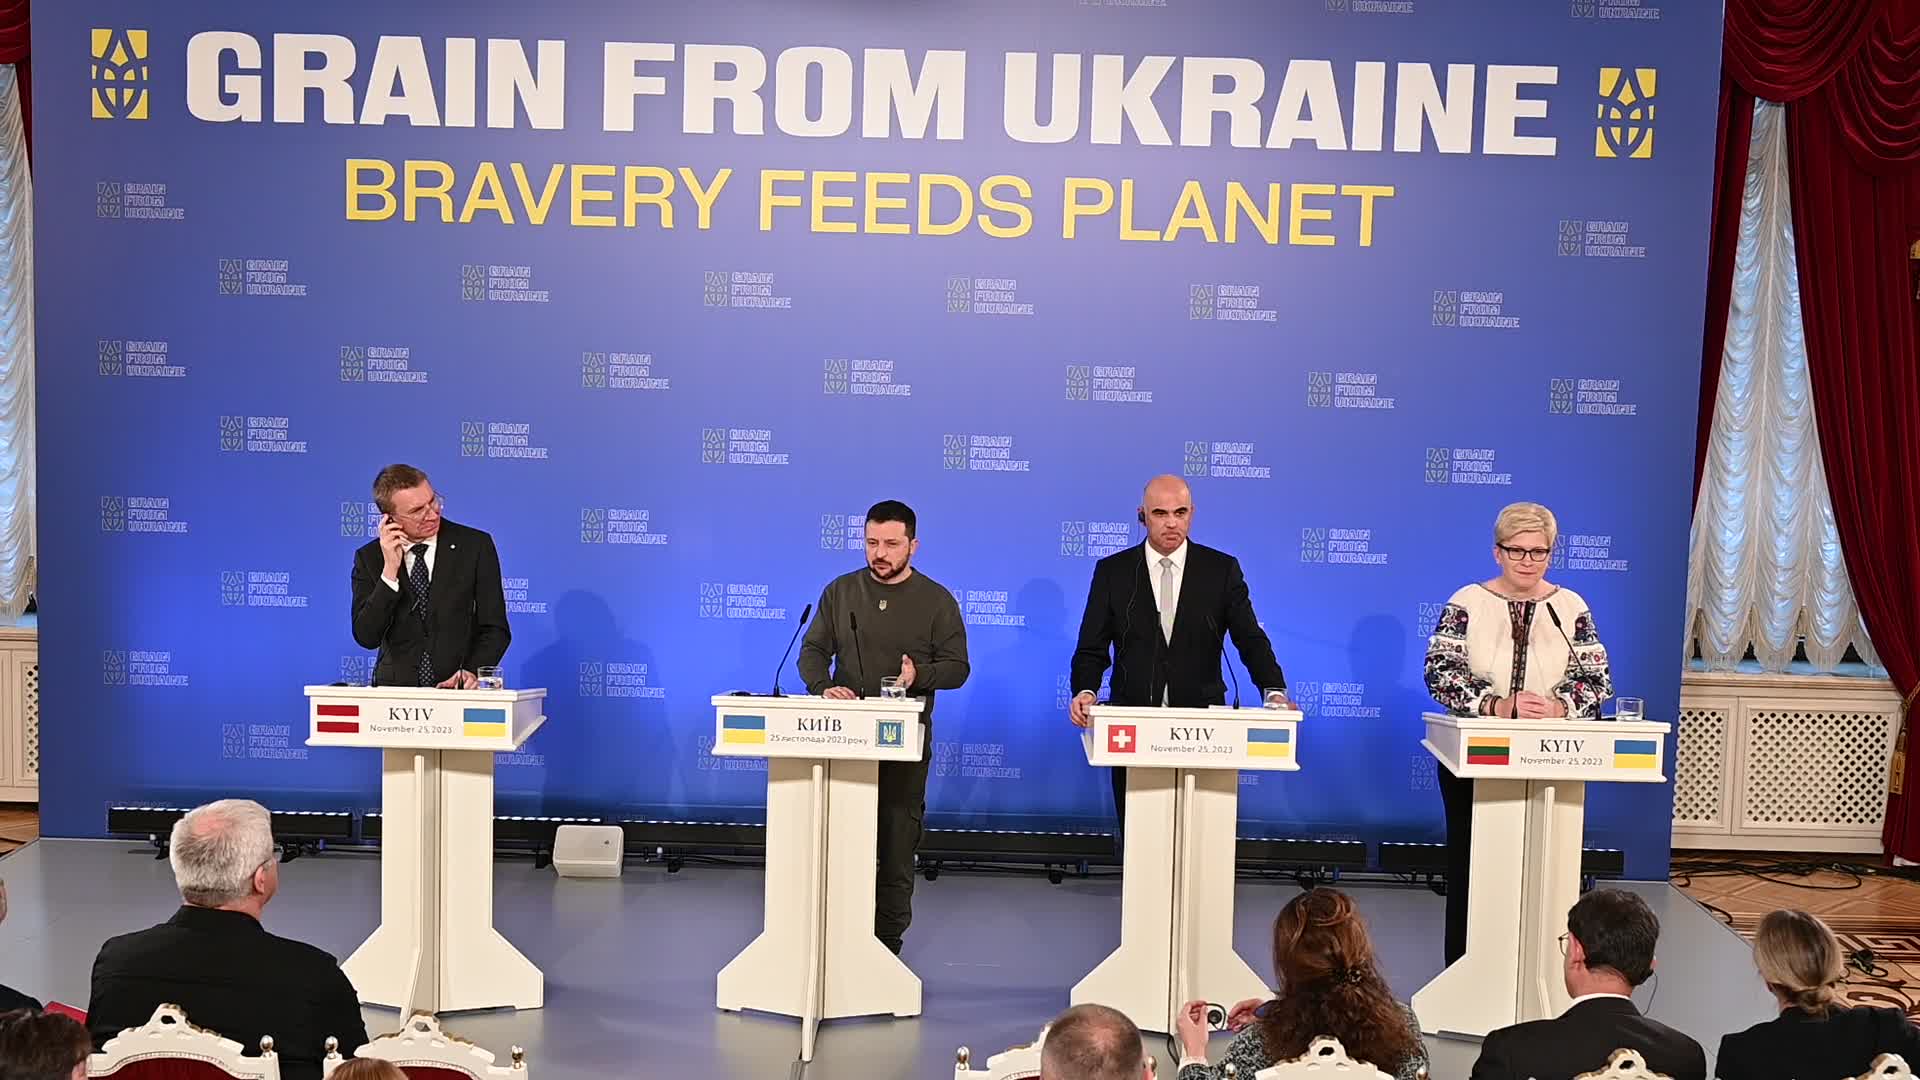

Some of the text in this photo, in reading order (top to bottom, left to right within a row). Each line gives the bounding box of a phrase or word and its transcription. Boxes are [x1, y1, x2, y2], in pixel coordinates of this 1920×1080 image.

[186, 31, 1558, 156] GRAIN FROM UKRAINE
[124, 184, 166, 194] GRAIN
[124, 195, 164, 206] FROM
[345, 159, 1395, 247] BRAVERY FEEDS PLANET
[124, 208, 184, 219] UKRAINE
[1586, 221, 1628, 232] GRAIN
[1586, 233, 1626, 244] FROM
[1585, 246, 1645, 257] UKRAINE
[246, 260, 288, 271] GRAIN
[489, 266, 530, 277] GRAIN
[247, 272, 286, 283] FROM
[732, 272, 773, 283] GRAIN
[489, 278, 528, 289] FROM
[975, 279, 1016, 290] GRAIN
[246, 284, 306, 295] UKRAINE
[732, 285, 771, 296] FROM
[1217, 285, 1259, 296] GRAIN
[489, 290, 549, 302] UKRAINE
[975, 291, 1014, 301] FROM
[1460, 292, 1502, 303] GRAIN
[732, 297, 791, 308] UKRAINE
[1217, 298, 1257, 308] FROM
[974, 303, 1034, 314] UKRAINE
[1460, 304, 1500, 315] FROM
[1217, 310, 1277, 321] UKRAINE
[1460, 316, 1520, 328] UKRAINE
[126, 341, 167, 352] GRAIN
[368, 347, 409, 358] GRAIN
[126, 354, 166, 364] FROM
[609, 353, 651, 364] GRAIN
[368, 359, 407, 370] FROM
[852, 360, 893, 371] GRAIN
[126, 365, 186, 376] UKRAINE
[610, 365, 649, 376] FROM
[1093, 366, 1135, 377] GRAIN
[368, 371, 427, 382] UKRAINE
[852, 372, 891, 383] FROM
[1335, 373, 1377, 384] GRAIN
[609, 378, 669, 389] UKRAINE
[1093, 379, 1133, 389] FROM
[1578, 379, 1619, 390] GRAIN
[851, 384, 911, 395] UKRAINE
[1335, 385, 1375, 396] FROM
[1093, 391, 1152, 402] UKRAINE
[1577, 392, 1617, 402] FROM
[1335, 397, 1394, 408] UKRAINE
[1577, 404, 1636, 415] UKRAINE
[247, 417, 288, 428] GRAIN
[488, 423, 529, 434] GRAIN
[247, 429, 287, 440] FROM
[489, 435, 528, 445] FROM
[729, 429, 771, 440] GRAIN
[247, 441, 307, 452] UKRAINE
[730, 441, 769, 452] FROM
[970, 436, 1012, 447] GRAIN
[488, 447, 548, 458] UKRAINE
[970, 448, 1009, 458] FROM
[1211, 443, 1253, 453] GRAIN
[729, 453, 789, 464] UKRAINE
[1212, 454, 1251, 465] FROM
[1453, 449, 1495, 460] GRAIN
[970, 460, 1029, 471] UKRAINE
[1453, 461, 1492, 472] FROM
[1211, 466, 1270, 478] UKRAINE
[1452, 473, 1512, 484] UKRAINE
[128, 497, 169, 508] GRAIN
[128, 509, 167, 520] FROM
[608, 509, 649, 520] GRAIN
[128, 521, 187, 532] UKRAINE
[608, 522, 647, 532] FROM
[1088, 522, 1129, 534] GRAIN
[608, 533, 667, 544] UKRAINE
[1088, 534, 1128, 545] FROM
[1329, 529, 1370, 540] GRAIN
[1570, 535, 1611, 546] GRAIN
[1329, 541, 1368, 552] FROM
[1569, 547, 1608, 558] FROM
[1328, 553, 1387, 564] UKRAINE
[1568, 559, 1628, 570] UKRAINE
[248, 572, 289, 583] GRAIN
[248, 584, 287, 594] FROM
[727, 584, 768, 595] GRAIN
[248, 595, 308, 607] UKRAINE
[727, 596, 766, 607] FROM
[966, 591, 1008, 602] GRAIN
[727, 608, 785, 619] UKRAINE
[966, 603, 1006, 613] FROM
[965, 614, 1025, 626] UKRAINE
[388, 708, 433, 720] KYIV
[370, 725, 415, 733] November
[797, 716, 842, 731] КИЇВ
[770, 734, 868, 746] 25 листопада 2023 року
[1170, 728, 1215, 741] KYIV
[1151, 745, 1196, 753] November
[1213, 746, 1233, 754] 2023
[1540, 739, 1584, 753] KYIV
[1520, 757, 1565, 765] November
[1582, 758, 1603, 766] 2023
